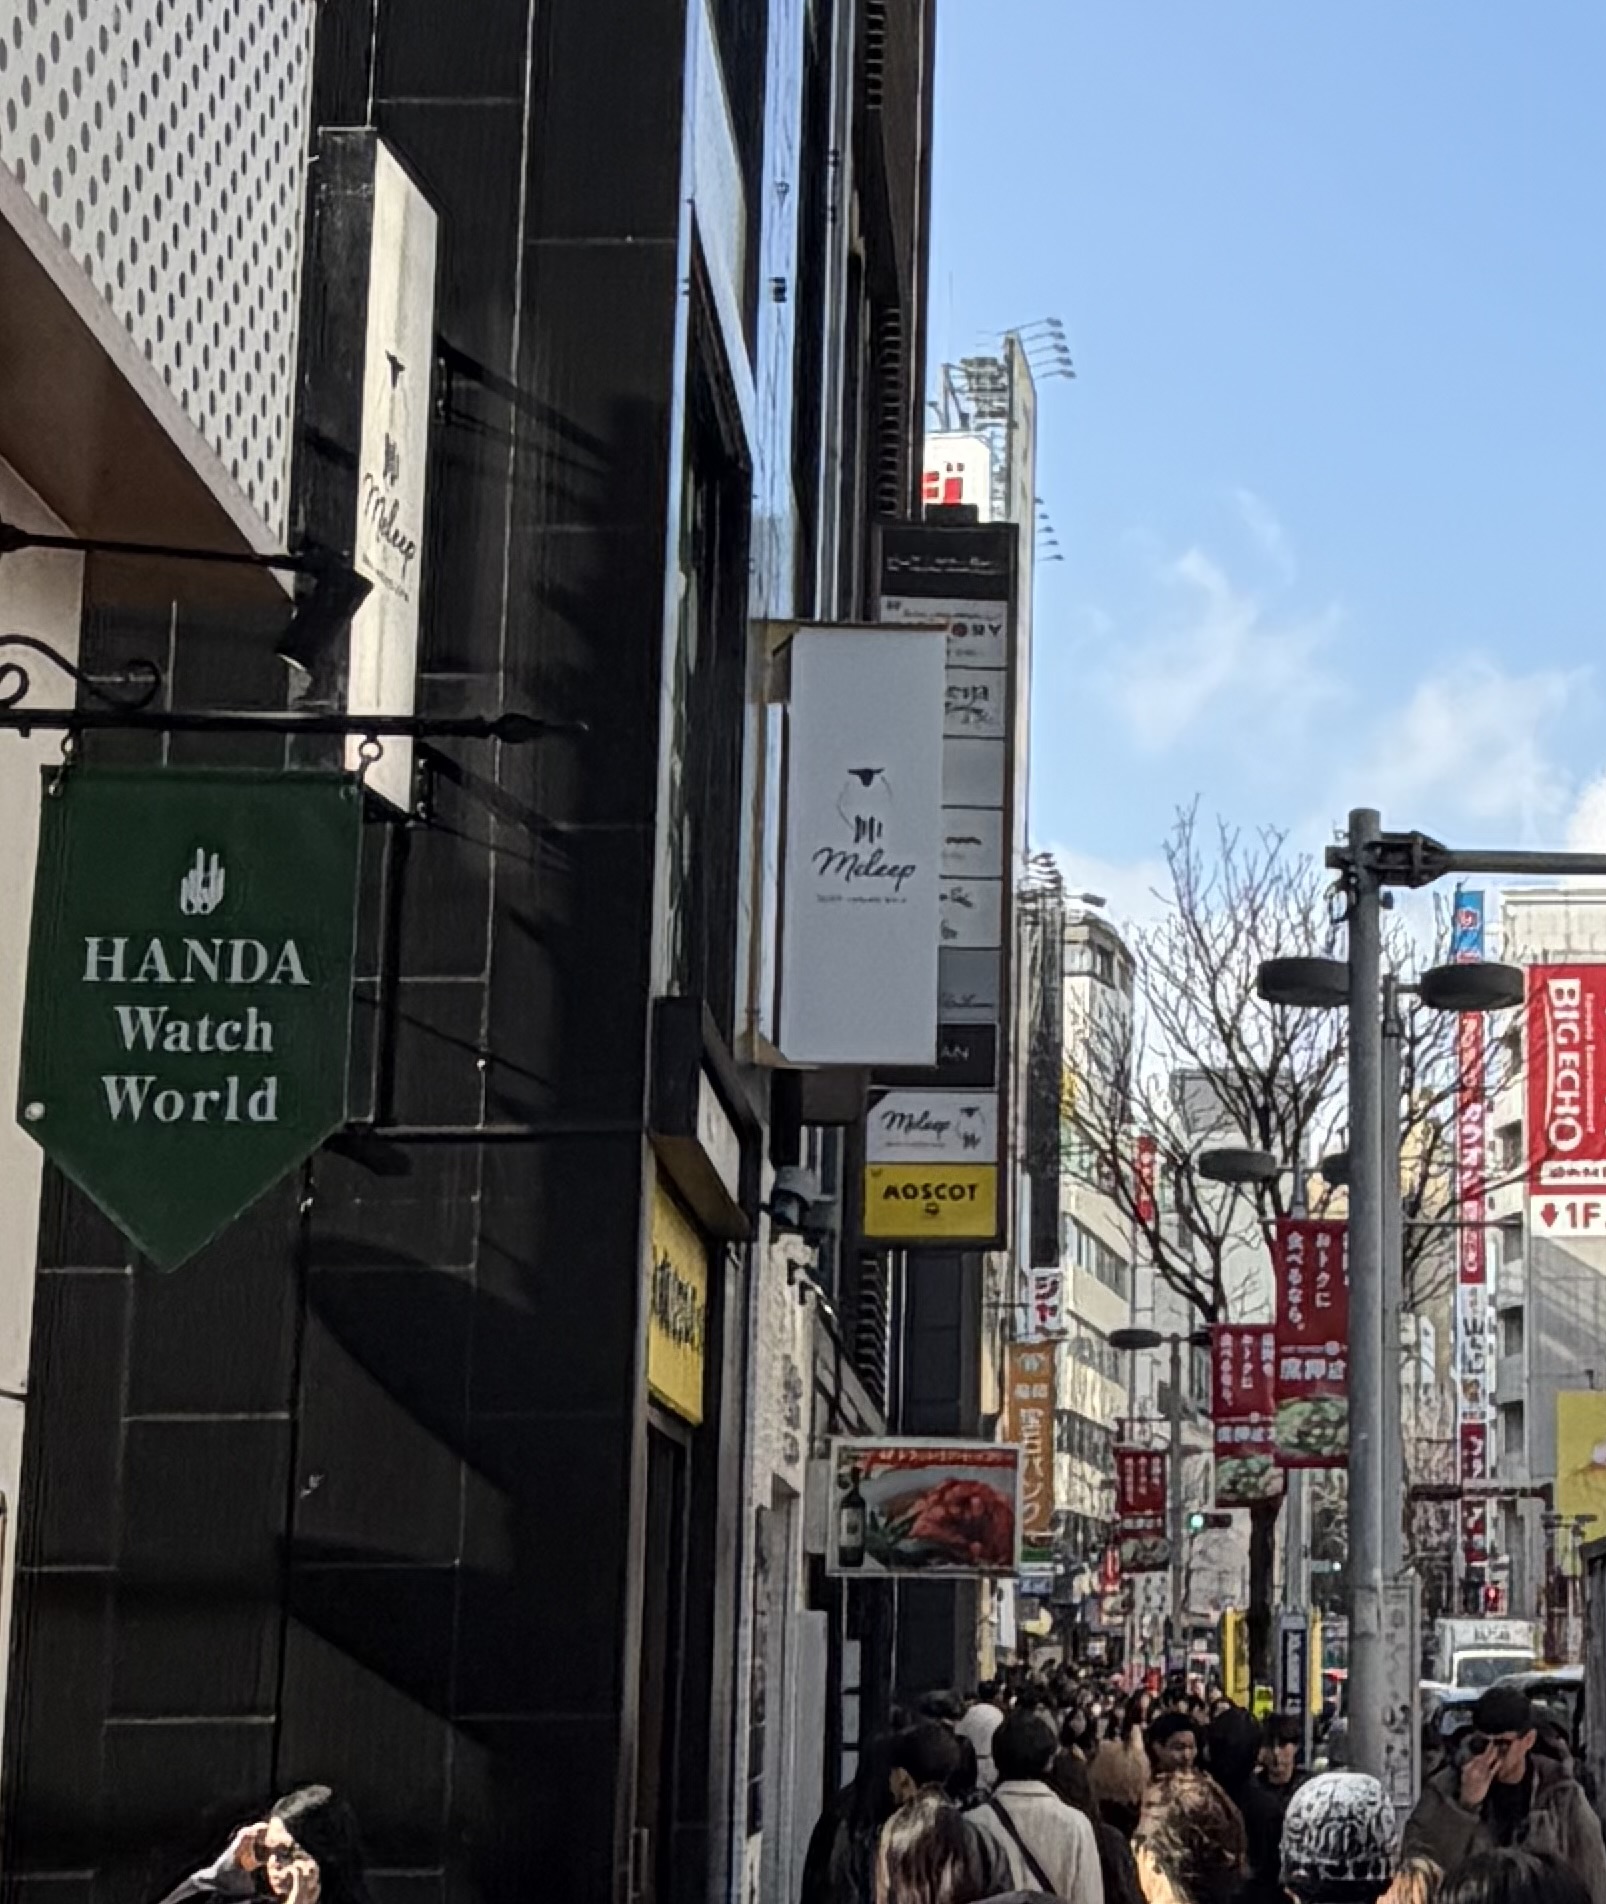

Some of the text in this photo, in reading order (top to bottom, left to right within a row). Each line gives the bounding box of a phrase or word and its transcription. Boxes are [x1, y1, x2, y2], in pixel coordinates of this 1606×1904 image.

[82, 936, 312, 986] HANDA
[113, 1005, 274, 1052] Watch
[1548, 978, 1583, 1152] BIG ECHO
[101, 1075, 278, 1123] World
[882, 1182, 979, 1201] MOSCOT
